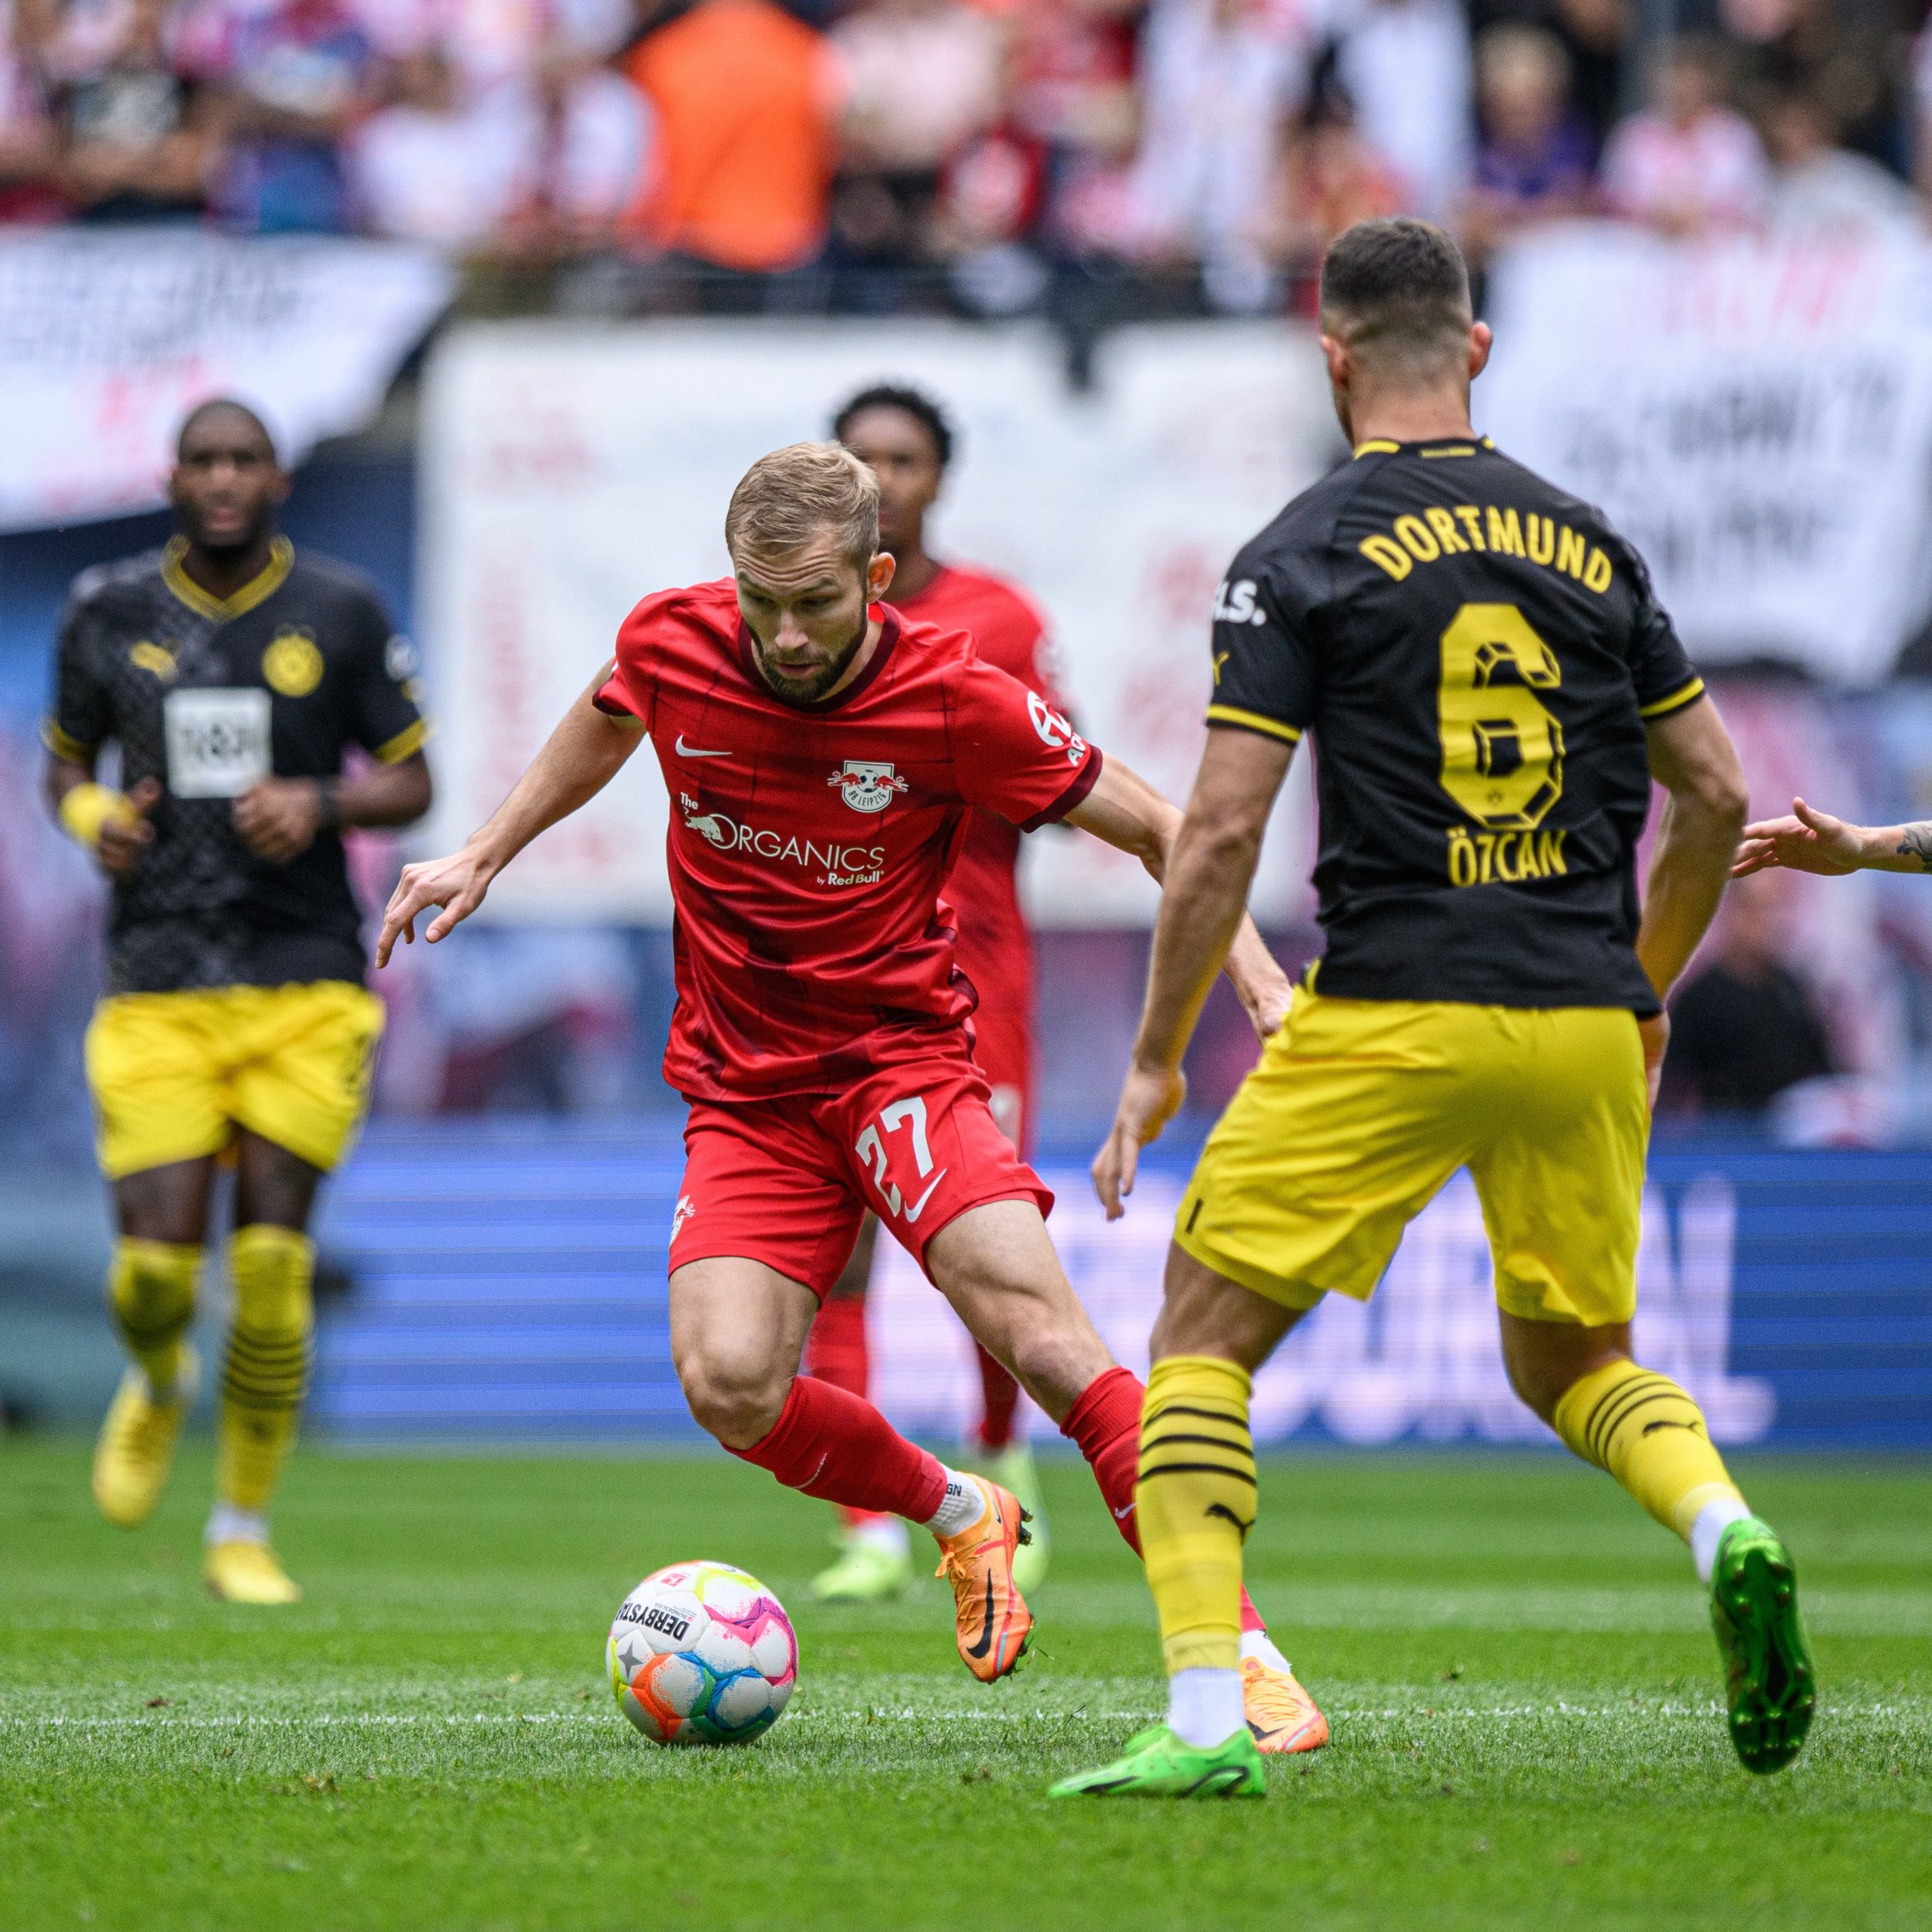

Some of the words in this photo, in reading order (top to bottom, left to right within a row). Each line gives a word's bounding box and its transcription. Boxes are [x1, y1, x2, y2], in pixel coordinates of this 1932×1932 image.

[1359, 506, 1612, 593] DORTMUND
[1438, 603, 1566, 829] 6
[680, 792, 699, 810] The
[848, 790, 859, 801] RB
[857, 792, 887, 807] LEIPZIG
[707, 814, 885, 872] ORGANICS
[1446, 826, 1568, 888] ÖZCAN
[817, 875, 826, 886] by
[828, 872, 854, 885] Red
[854, 1096, 934, 1218] 27
